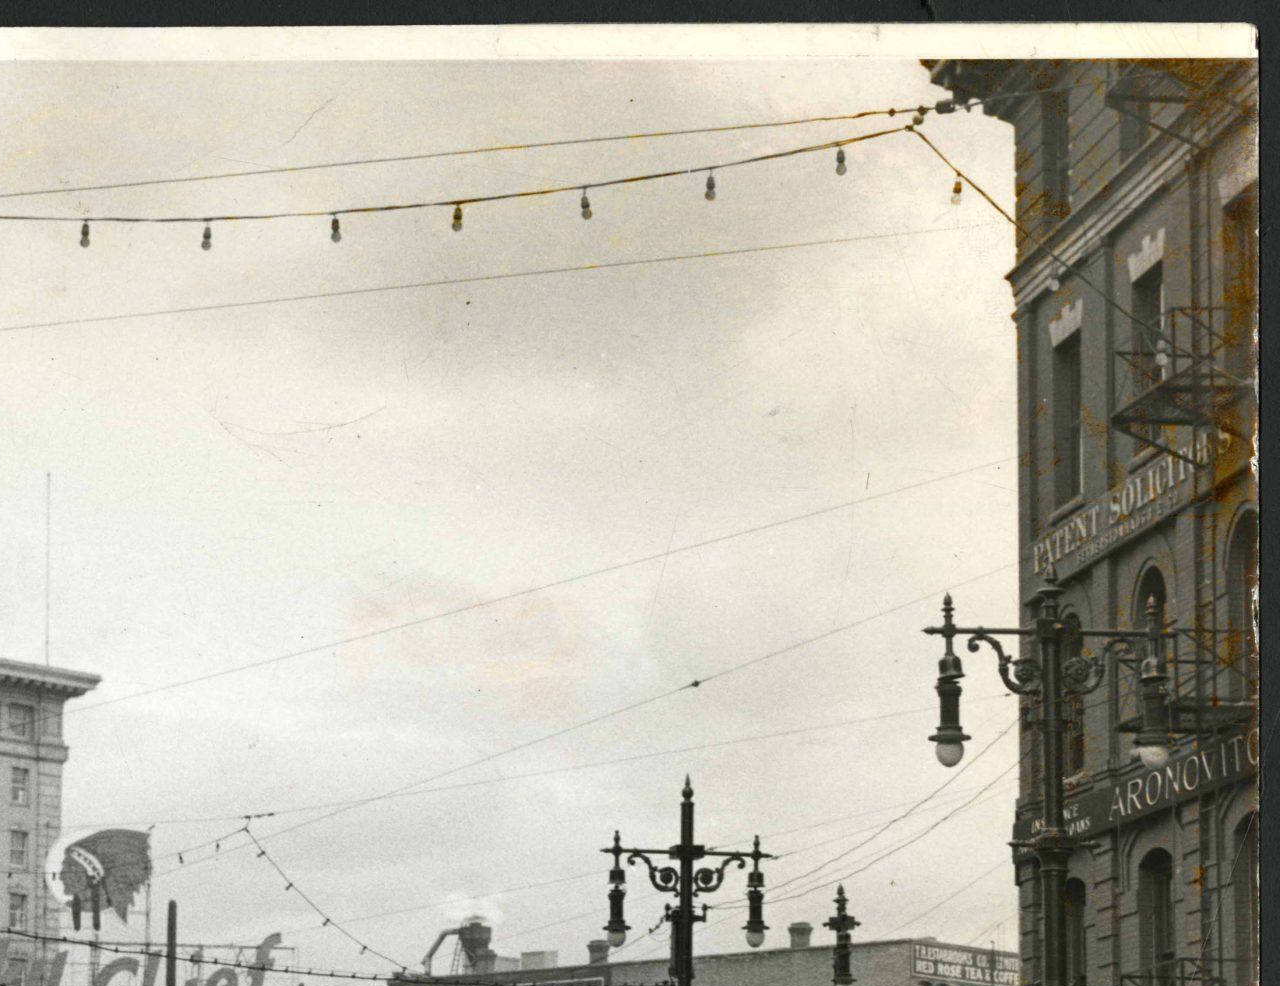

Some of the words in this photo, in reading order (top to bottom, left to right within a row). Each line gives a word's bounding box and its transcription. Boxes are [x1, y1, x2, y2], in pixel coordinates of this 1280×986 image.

[1033, 505, 1100, 575] PATENT
[1109, 430, 1232, 524] SOLICITORS
[1031, 803, 1079, 833] INSNCE
[915, 960, 935, 974] RED
[937, 962, 963, 978] ROSE
[965, 966, 983, 981] TEA
